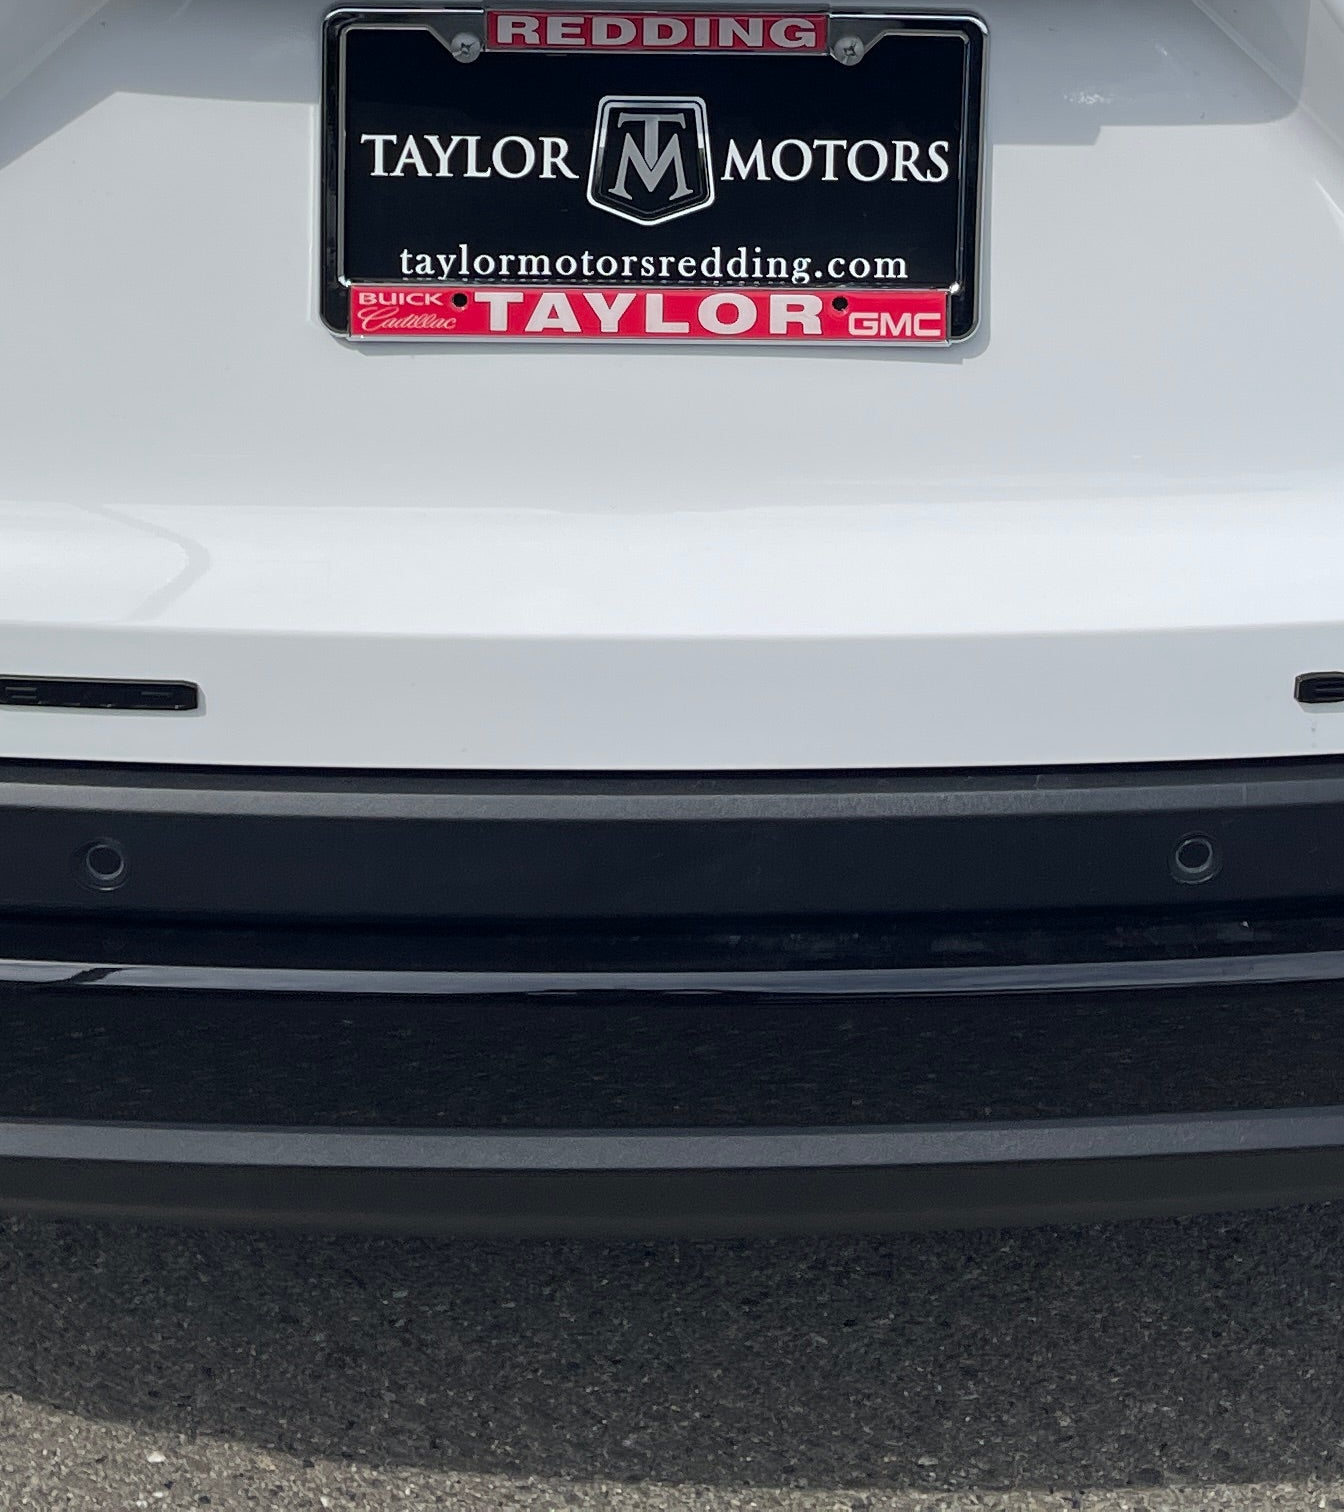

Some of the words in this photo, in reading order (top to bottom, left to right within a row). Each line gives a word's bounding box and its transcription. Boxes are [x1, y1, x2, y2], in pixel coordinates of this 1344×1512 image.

[496, 14, 816, 48] REDDING
[360, 133, 580, 180] TAYLOR
[720, 138, 949, 183] MOTORS
[399, 243, 908, 285] taylormotorsredding.com
[358, 291, 443, 306] BUICK
[473, 291, 823, 335] TAYLOR
[357, 306, 458, 332] Cadillac
[847, 312, 942, 337] GMC
